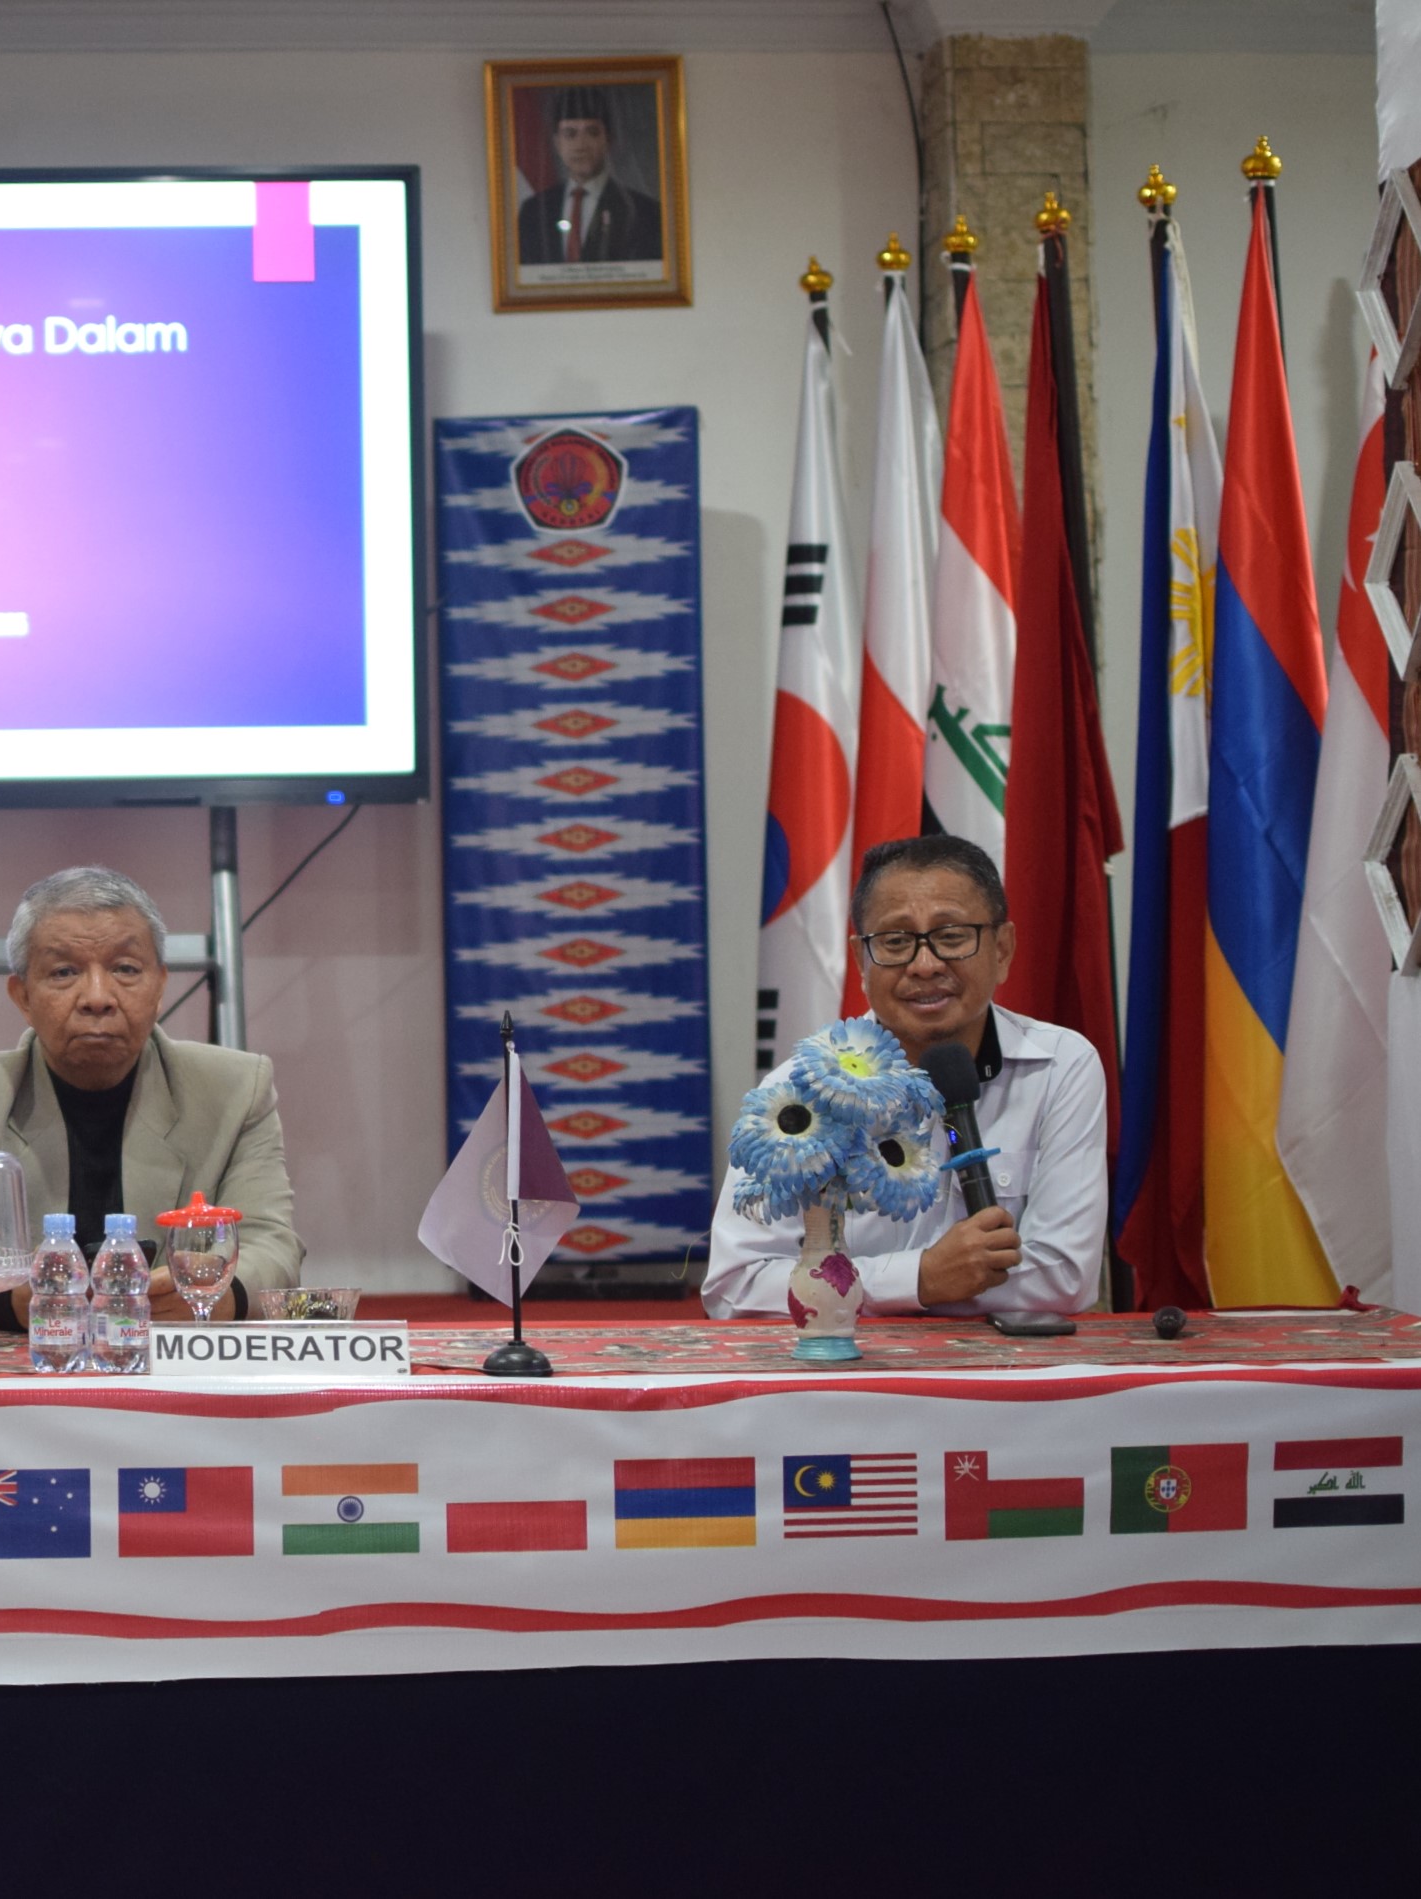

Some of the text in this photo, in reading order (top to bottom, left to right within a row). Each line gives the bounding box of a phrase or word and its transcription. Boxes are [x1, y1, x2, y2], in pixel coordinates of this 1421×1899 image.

[44, 314, 188, 354] Dalam
[34, 1327, 73, 1337] Minerale
[48, 1317, 61, 1328] Le
[155, 1334, 406, 1362] MODERATOR
